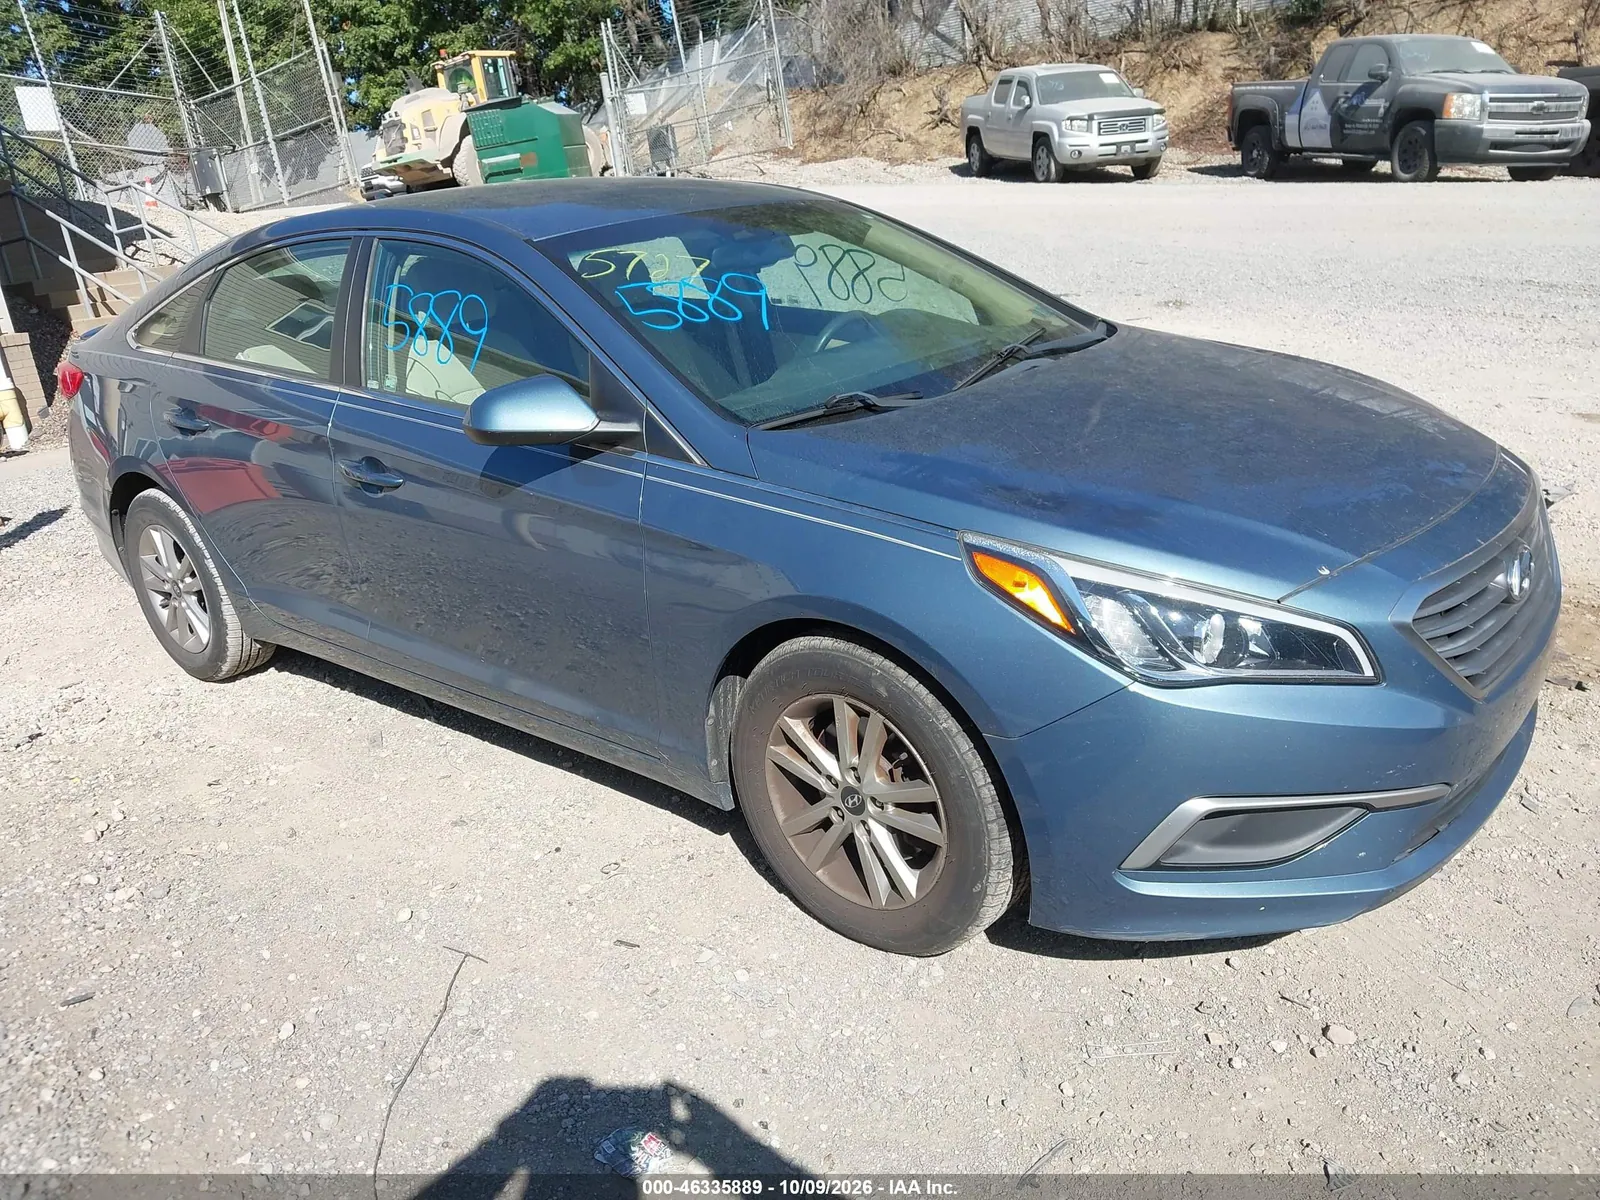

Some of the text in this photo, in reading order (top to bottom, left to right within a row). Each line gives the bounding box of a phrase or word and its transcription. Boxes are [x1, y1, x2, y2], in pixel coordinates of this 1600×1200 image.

[580, 248, 711, 285] 5727
[383, 284, 489, 374] 5889
[614, 272, 770, 331] 5889
